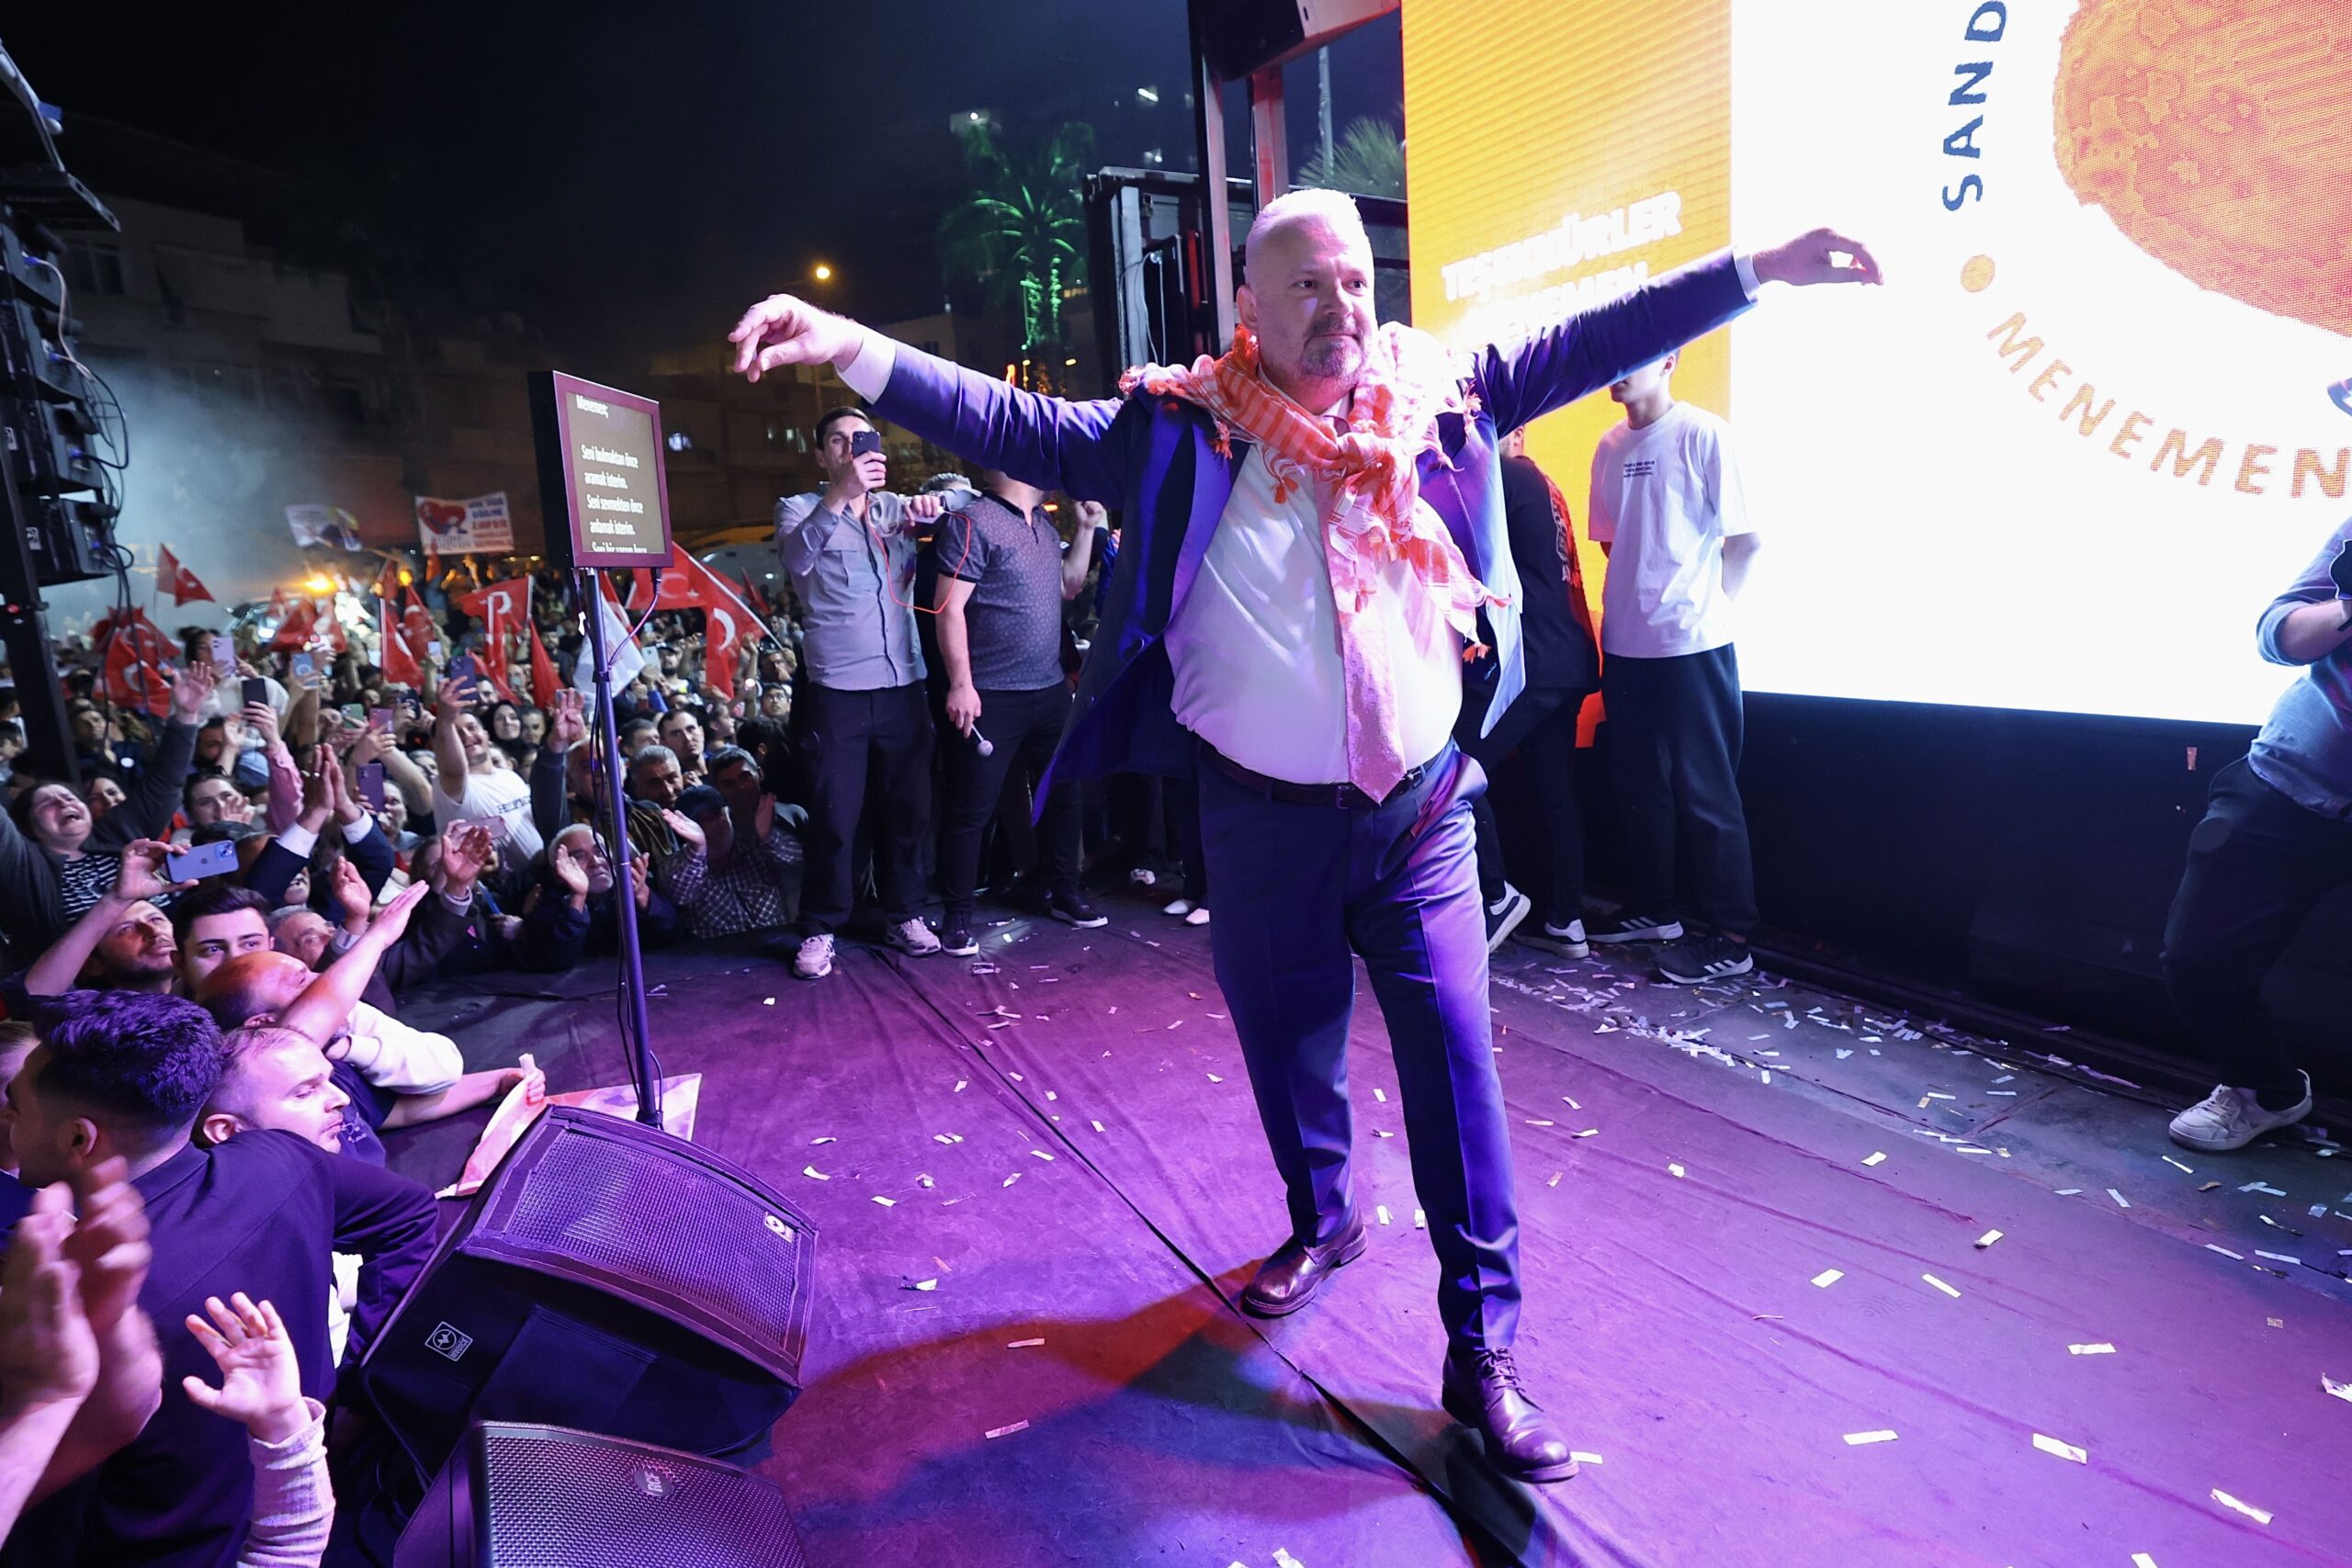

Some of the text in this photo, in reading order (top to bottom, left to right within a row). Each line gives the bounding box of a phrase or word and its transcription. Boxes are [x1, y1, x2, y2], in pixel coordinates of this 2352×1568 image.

[1441, 190, 1682, 303] TEŞEKKÜRLER
[1986, 311, 2352, 499] MENEMEN
[581, 444, 595, 461] Seni
[625, 452, 639, 468] önce
[584, 470, 606, 486] aramak
[586, 493, 644, 514] Seni sevmekten önce
[643, 1471, 663, 1494] RCF
